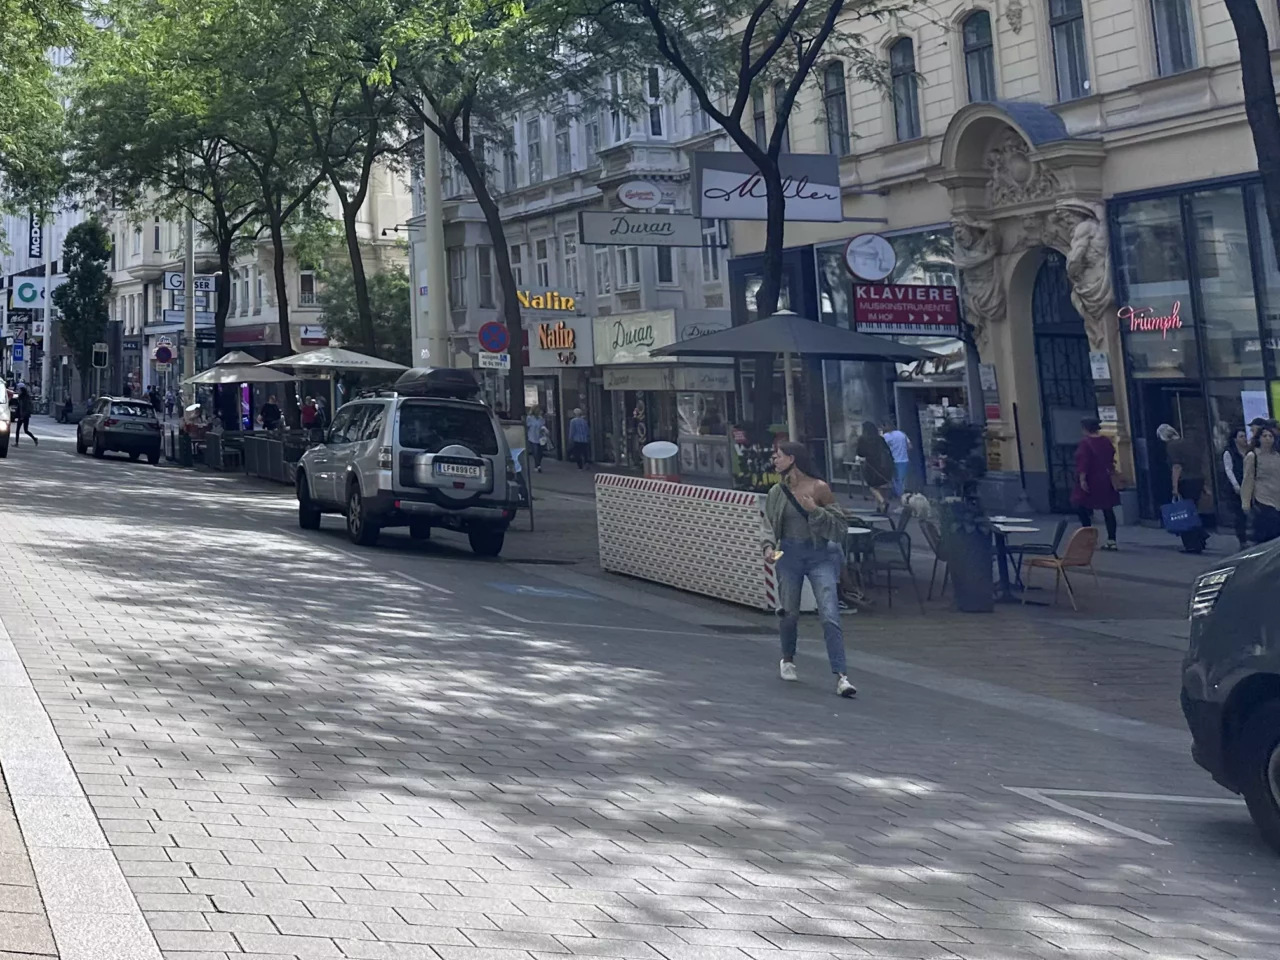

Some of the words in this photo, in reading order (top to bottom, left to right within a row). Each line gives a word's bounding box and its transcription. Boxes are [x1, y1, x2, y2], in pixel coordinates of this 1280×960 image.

[703, 169, 839, 202] Mller
[609, 215, 676, 236] Duran
[516, 290, 575, 311] Nalin
[856, 285, 954, 301] KLAVIERE
[859, 302, 952, 313] MUSIKINSTRUMENTE
[867, 312, 877, 320] IM
[879, 313, 894, 321] HOF
[1117, 299, 1183, 340] Triumph
[612, 318, 656, 350] Duran
